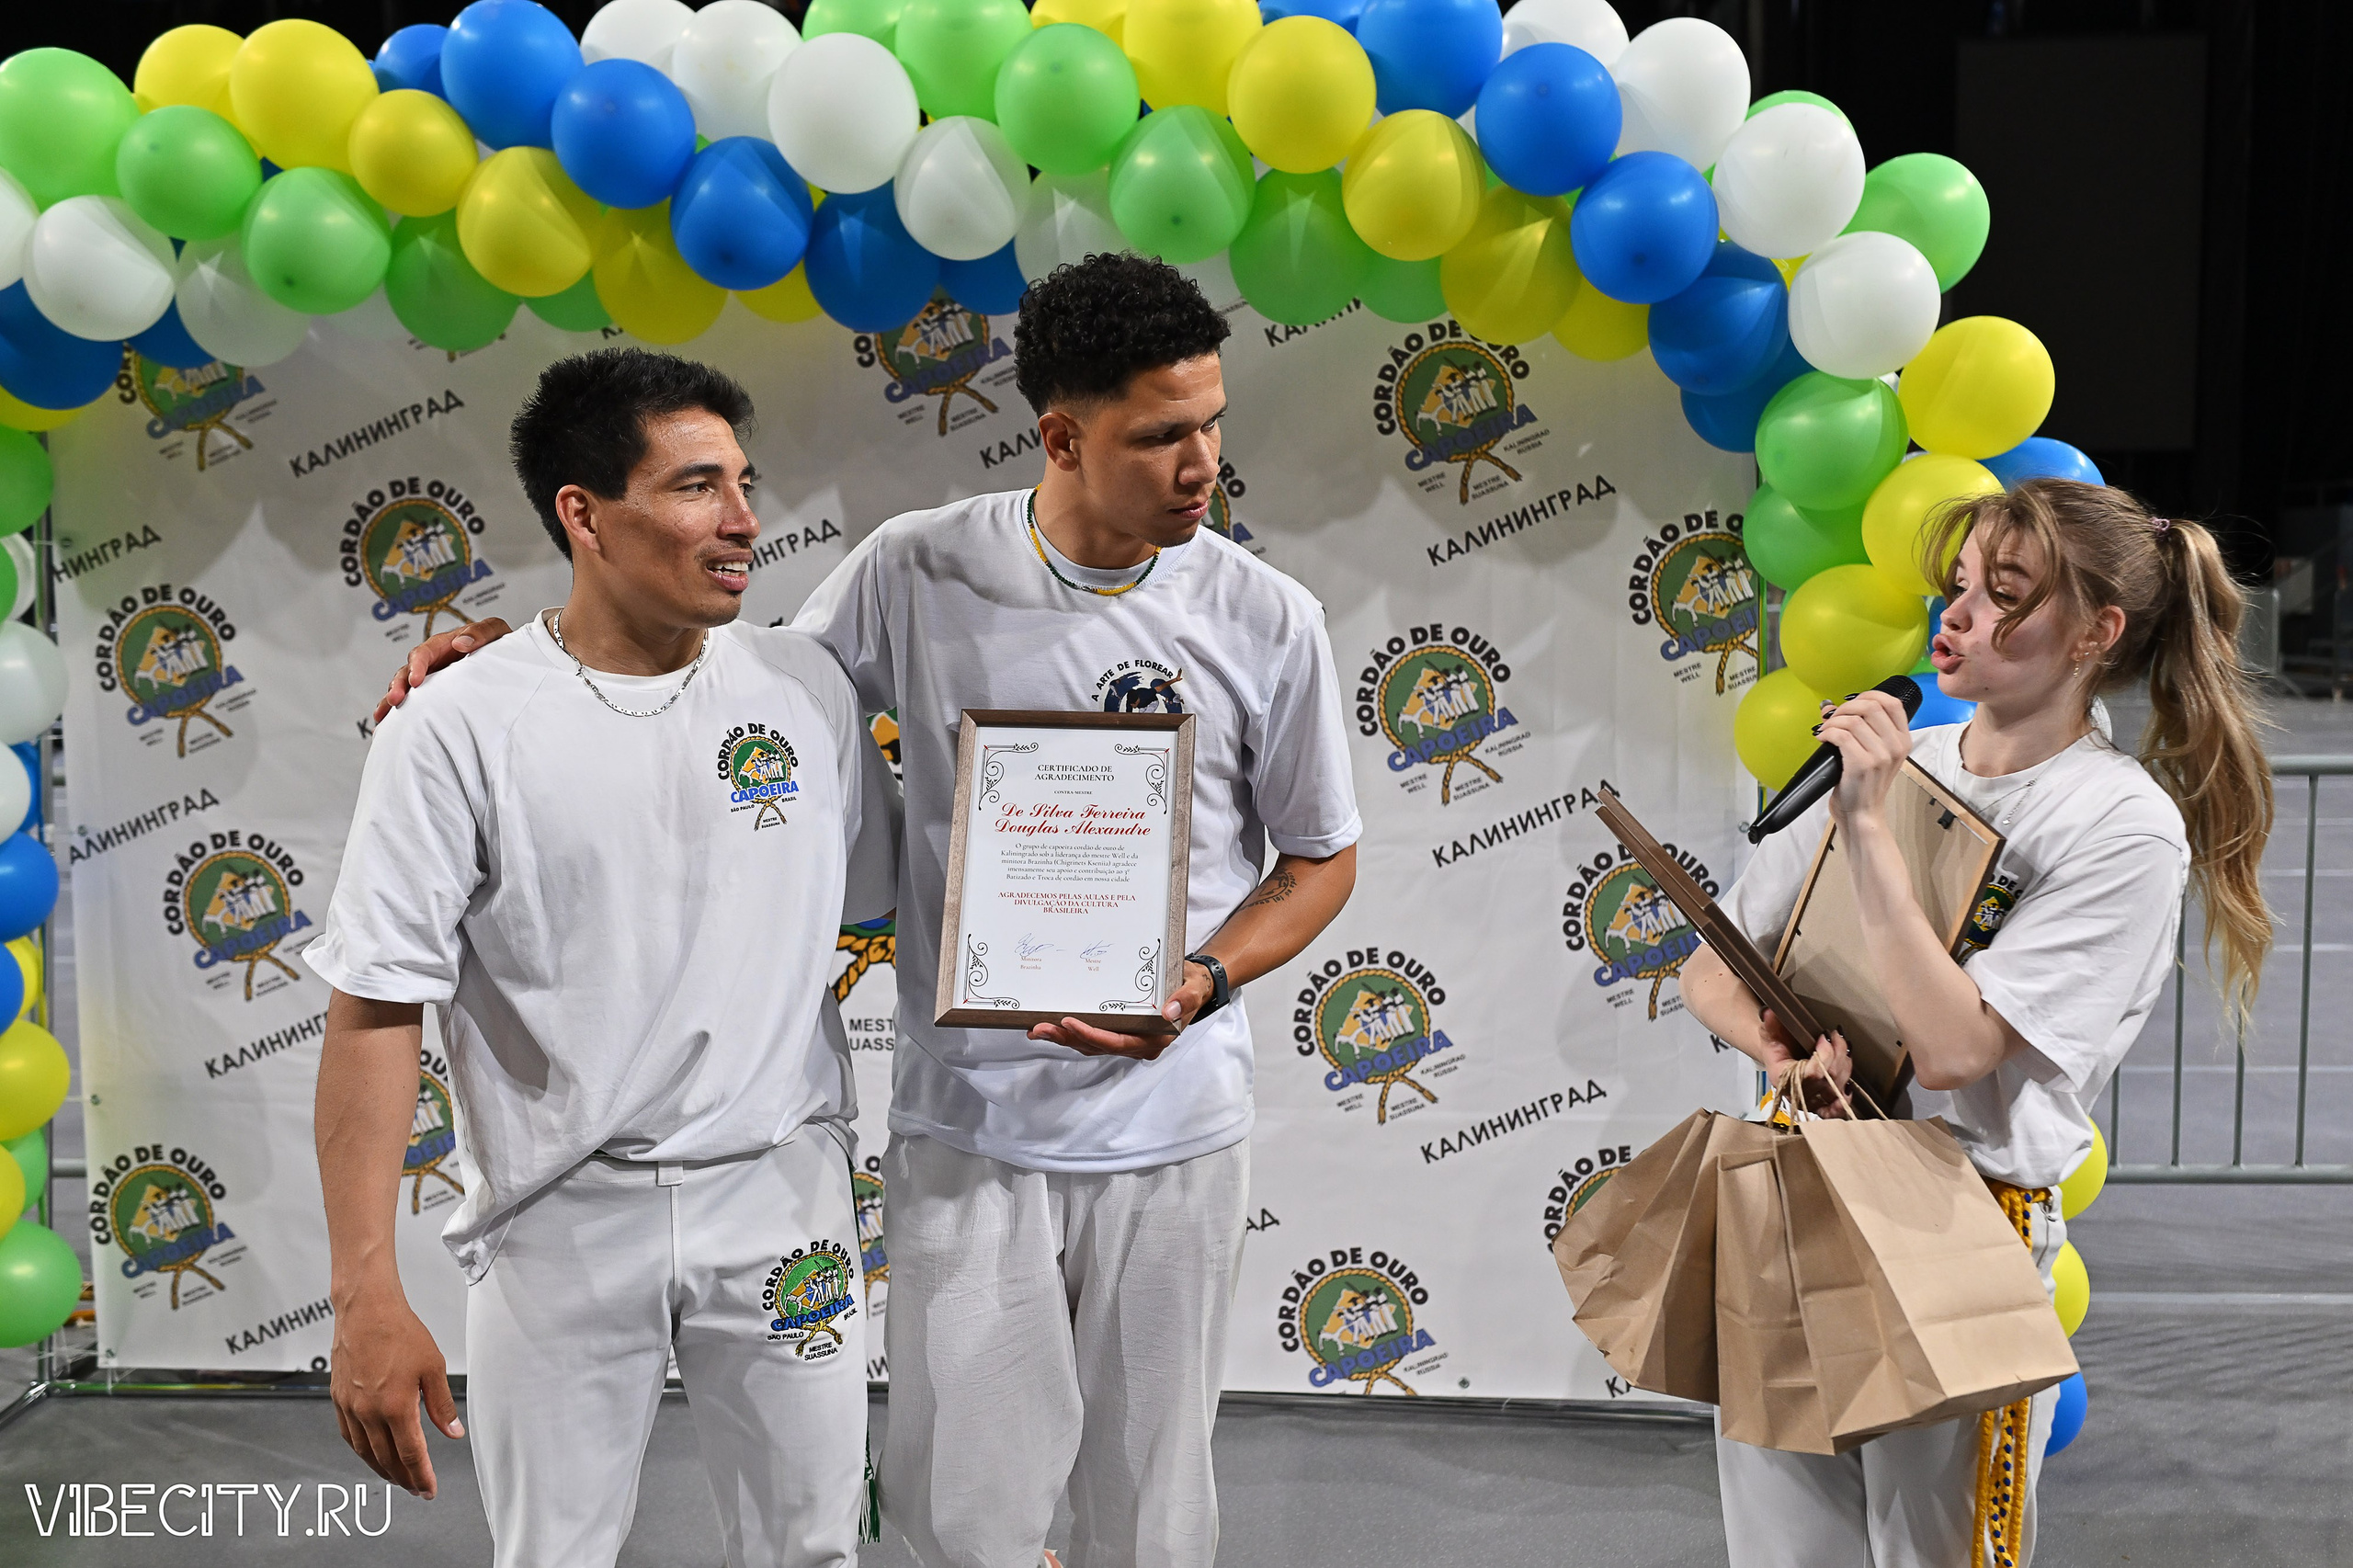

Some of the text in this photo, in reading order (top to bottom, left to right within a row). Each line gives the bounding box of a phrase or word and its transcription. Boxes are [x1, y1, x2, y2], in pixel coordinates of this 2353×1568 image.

[1373, 320, 1462, 436] CORDÃO DE
[289, 389, 464, 477] КАЛИНИНГРАД
[1404, 403, 1538, 472] CAPOEIRA
[339, 477, 485, 587] CORDÃO DE OURO
[1427, 474, 1617, 566] КАЛИНИНГРАД
[1629, 510, 1719, 625] CORDÃO DE
[96, 584, 237, 691] CORDÃO DE OURO
[1660, 604, 1757, 661] CAPOEI
[1091, 659, 1174, 702] A ARTE DE FLOREAR
[1356, 623, 1511, 736] CORDÃO DE OURO
[717, 723, 799, 779] CORDÃO DE OURO
[1038, 765, 1113, 773] CERTIFICADO DE
[1387, 707, 1519, 772] CAPOEIRA
[731, 780, 799, 803] CAPOEIRA
[1034, 773, 1115, 782] AGRADECIMENTO
[1400, 774, 1427, 789] MESTRE
[1454, 777, 1483, 792] MESTRE
[995, 818, 1151, 837] Douglas Alexandre
[1001, 802, 1146, 820] De Silva Ferreira
[1048, 844, 1073, 852] capoeira
[163, 830, 304, 936] CORDÃO DE OURO
[998, 892, 1057, 900] AGRADECEMOS
[1043, 906, 1089, 915] BRASILEIRA
[1563, 852, 1613, 950] CORDÃO
[194, 909, 313, 969] CAPOEIRA
[1293, 948, 1446, 1056] CORDÃO DE OURO
[1324, 1029, 1453, 1091] CAPOEIRA
[1420, 1079, 1607, 1164] КАЛИНИНГРАД
[1597, 1146, 1631, 1166] DE
[89, 1143, 226, 1245] CORDÃO DE OURO
[762, 1248, 804, 1311] CORDÃO
[810, 1239, 830, 1251] DE
[832, 1243, 854, 1278] OURO
[1278, 1247, 1428, 1352] CORDÃO DE OURO
[770, 1294, 856, 1332] CAPOEIRA
[781, 1331, 804, 1340] PAULO
[804, 1346, 838, 1361] SUASSUNA
[809, 1341, 833, 1353] MESTRE
[1309, 1328, 1437, 1387] CAPOEIRA
